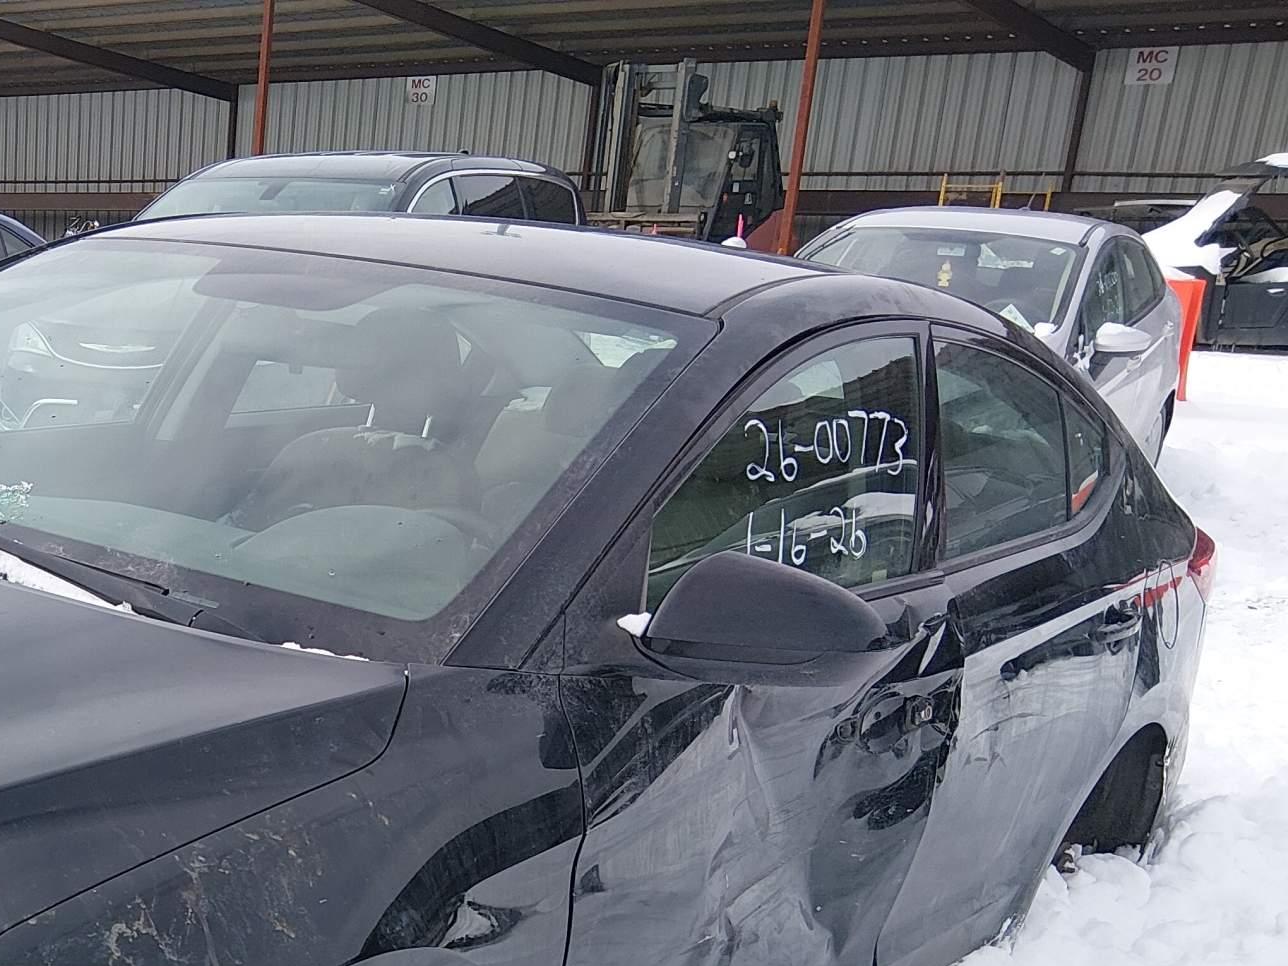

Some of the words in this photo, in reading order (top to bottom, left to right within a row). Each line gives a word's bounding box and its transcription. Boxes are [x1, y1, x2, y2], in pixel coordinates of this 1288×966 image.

[1137, 50, 1168, 64] MC
[1136, 68, 1162, 81] 20
[411, 79, 430, 89] MC
[412, 92, 428, 103] 30
[744, 410, 908, 482] 26-00773
[746, 506, 866, 566] 1-16-26
